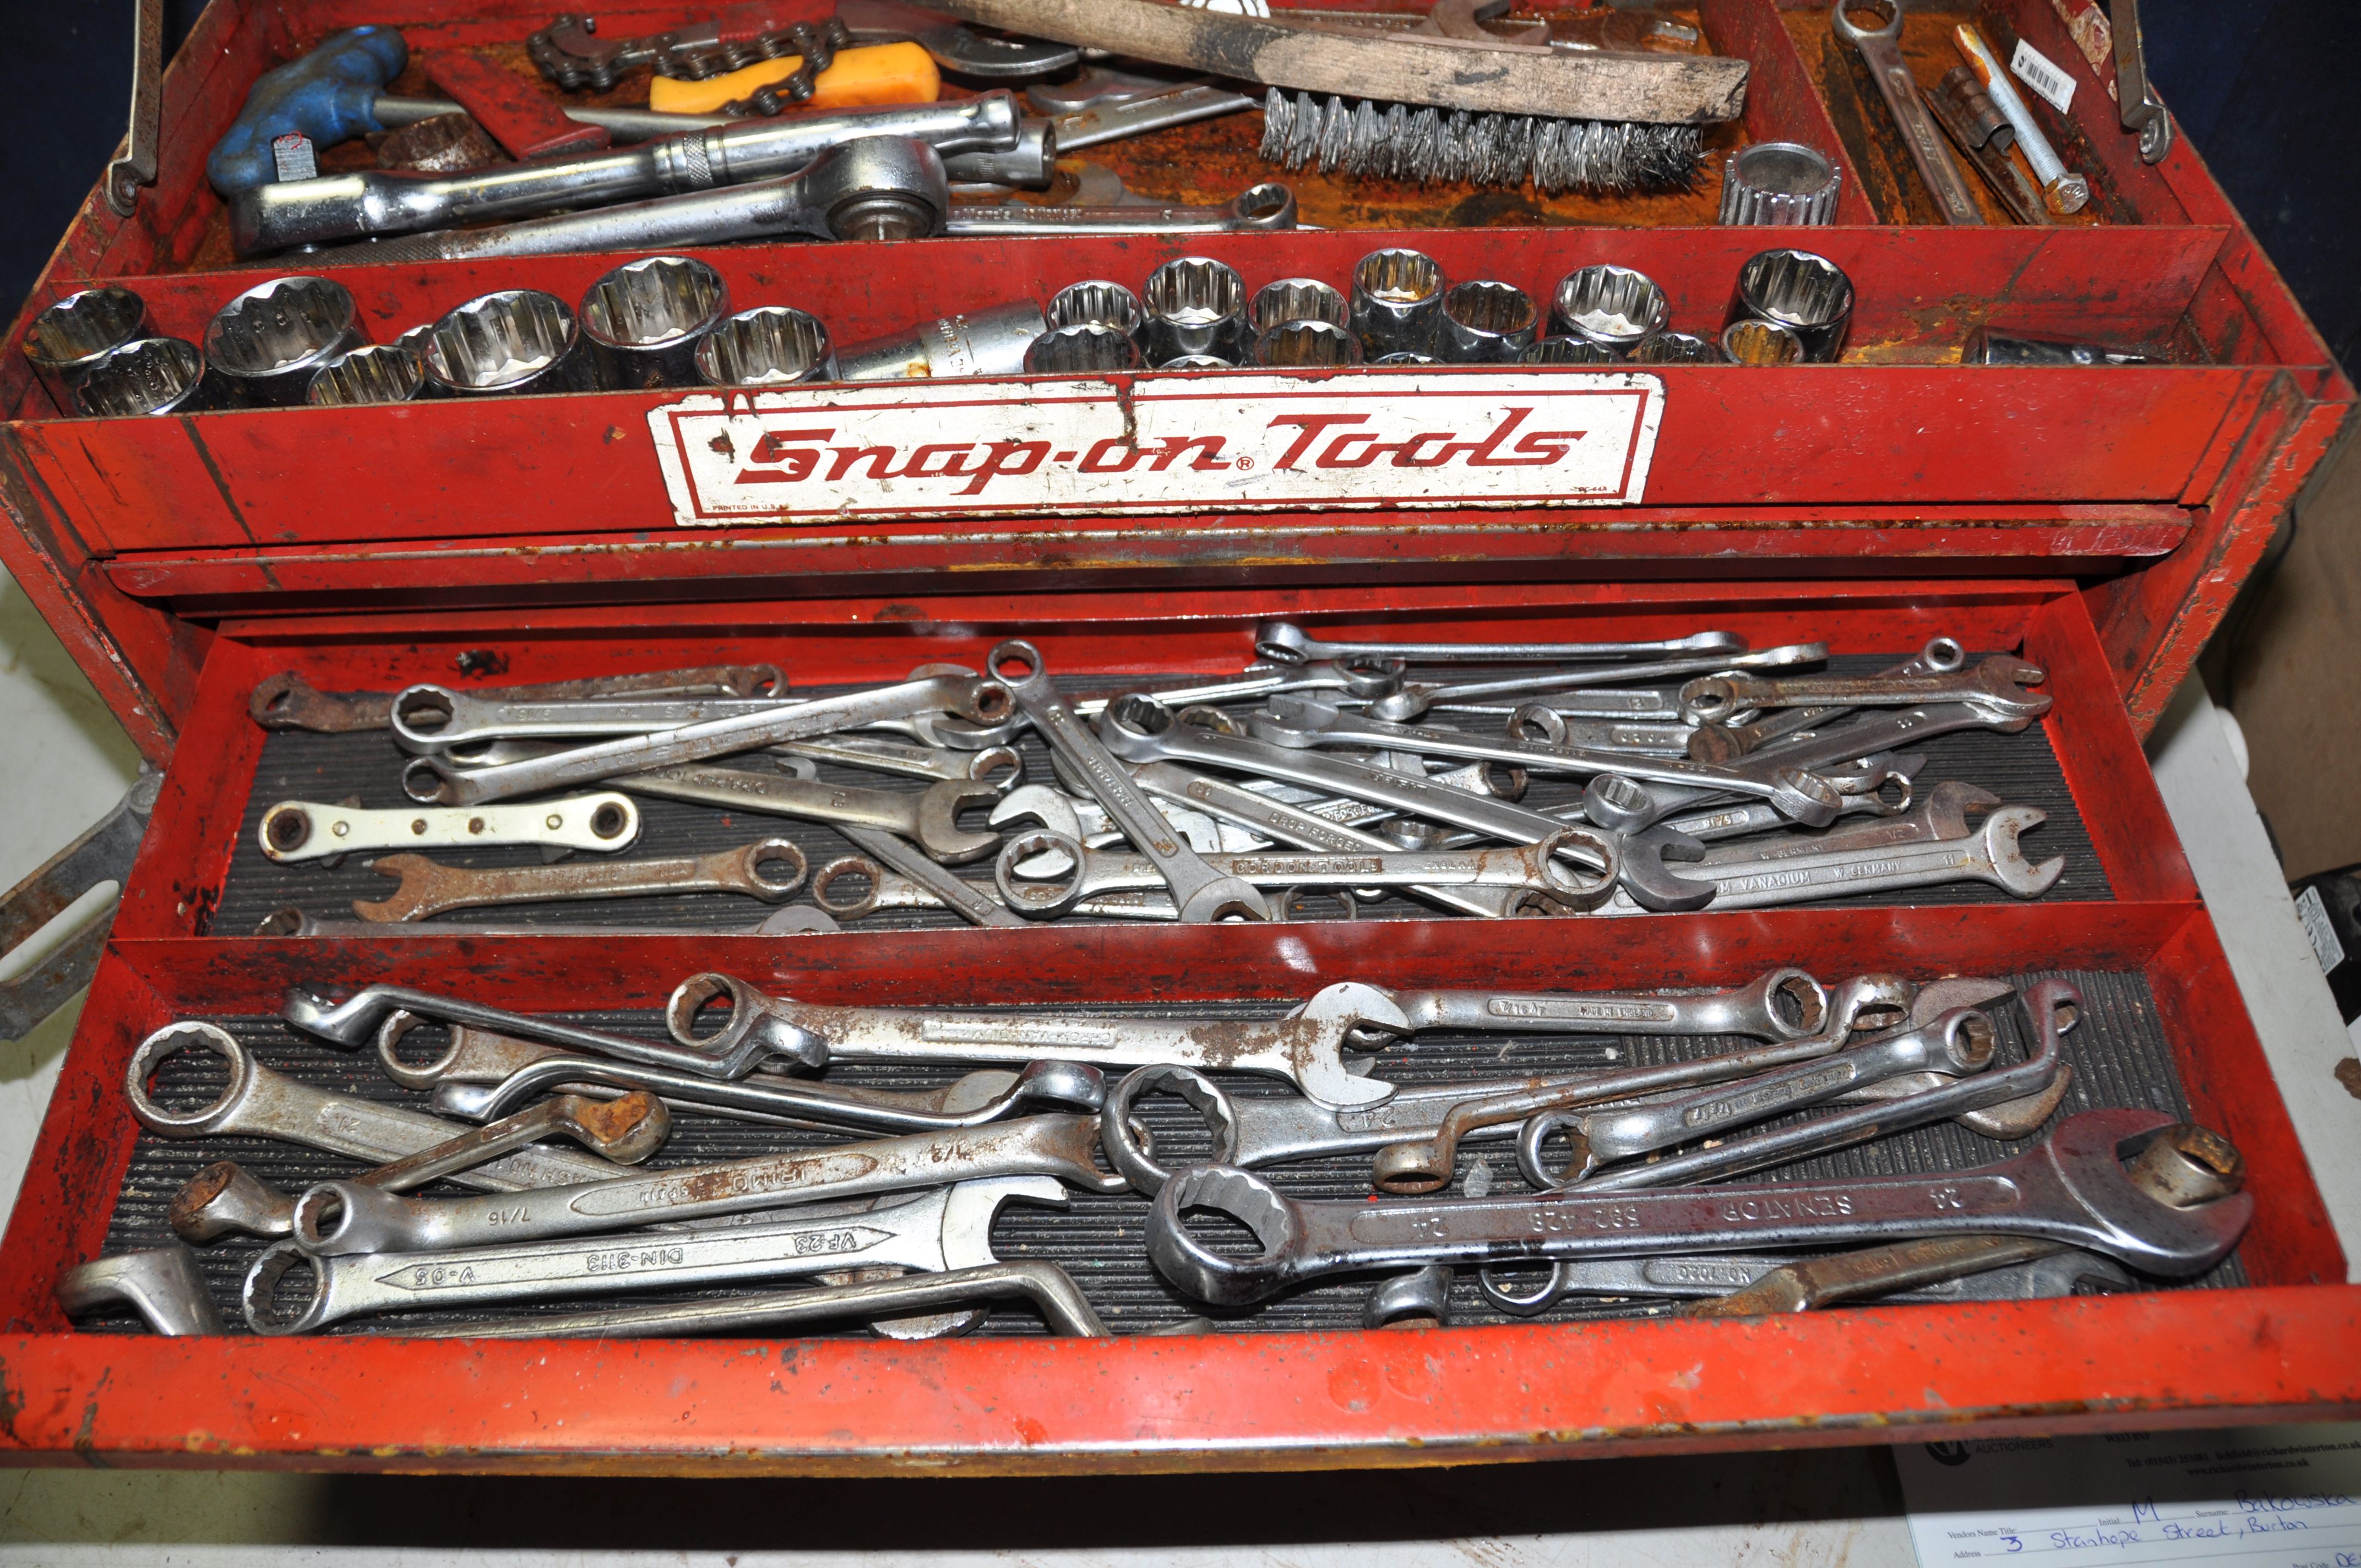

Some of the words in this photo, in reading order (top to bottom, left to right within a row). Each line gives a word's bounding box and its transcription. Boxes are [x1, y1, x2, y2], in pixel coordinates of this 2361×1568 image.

[735, 428, 1232, 495] Snap-on
[1272, 407, 1590, 469] Tools
[1269, 811, 1304, 834] DROP
[1307, 826, 1364, 851] FORGED
[1237, 861, 1308, 874] GORDON
[1317, 860, 1378, 874] TOOLS
[1740, 871, 1811, 890] VANADIUM
[1851, 861, 1901, 878] GERMANY
[732, 1169, 807, 1193] IRIMO
[639, 1185, 689, 1204] SPAIN
[487, 1207, 531, 1227] 7/16
[1722, 1194, 1853, 1222] SENATOR
[796, 1231, 857, 1253] VF-23
[587, 1248, 684, 1273] DIN-3113
[415, 1267, 476, 1287] V-05
[1976, 1439, 2053, 1454] AUCTIONEERS
[2124, 1458, 2143, 1468] Tel:
[2186, 1458, 2310, 1476] www.richardwinterton.co.uk
[2132, 1494, 2161, 1525] M
[2195, 1509, 2229, 1518] Surname:
[2098, 1518, 2121, 1527] Initial:
[1947, 1529, 1977, 1540] Vendors
[1977, 1528, 1998, 1538] Name
[1998, 1527, 2018, 1536] Title:
[2000, 1536, 2023, 1552] 3
[2050, 1527, 2142, 1549] Stanhope
[1953, 1550, 1982, 1560] Address
[2335, 1552, 2361, 1568] DE
